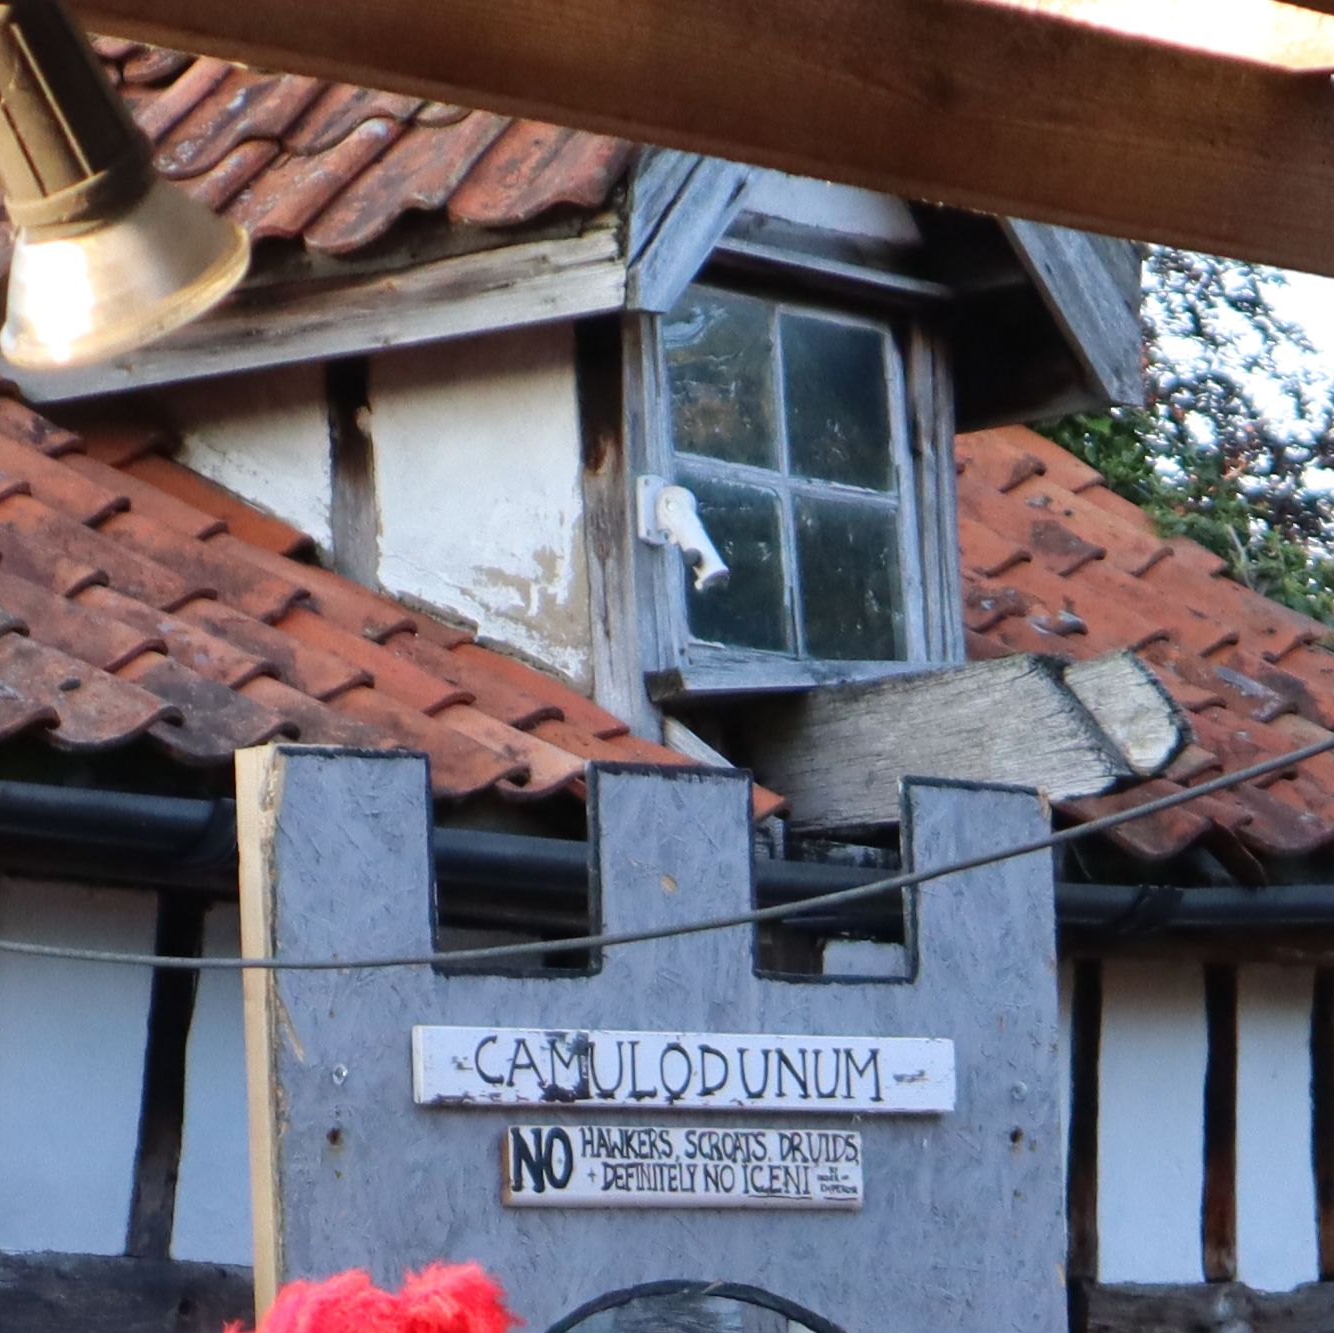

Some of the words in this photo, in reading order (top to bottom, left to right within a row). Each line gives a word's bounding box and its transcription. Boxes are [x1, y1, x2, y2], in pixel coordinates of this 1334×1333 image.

[475, 1034, 884, 1103] CAMULODUNUM
[510, 1126, 574, 1194] NO
[778, 1131, 860, 1166] DRUIDS,
[601, 1161, 699, 1194] DEFINITELY
[702, 1163, 735, 1194] NO
[741, 1164, 812, 1195] ICENI
